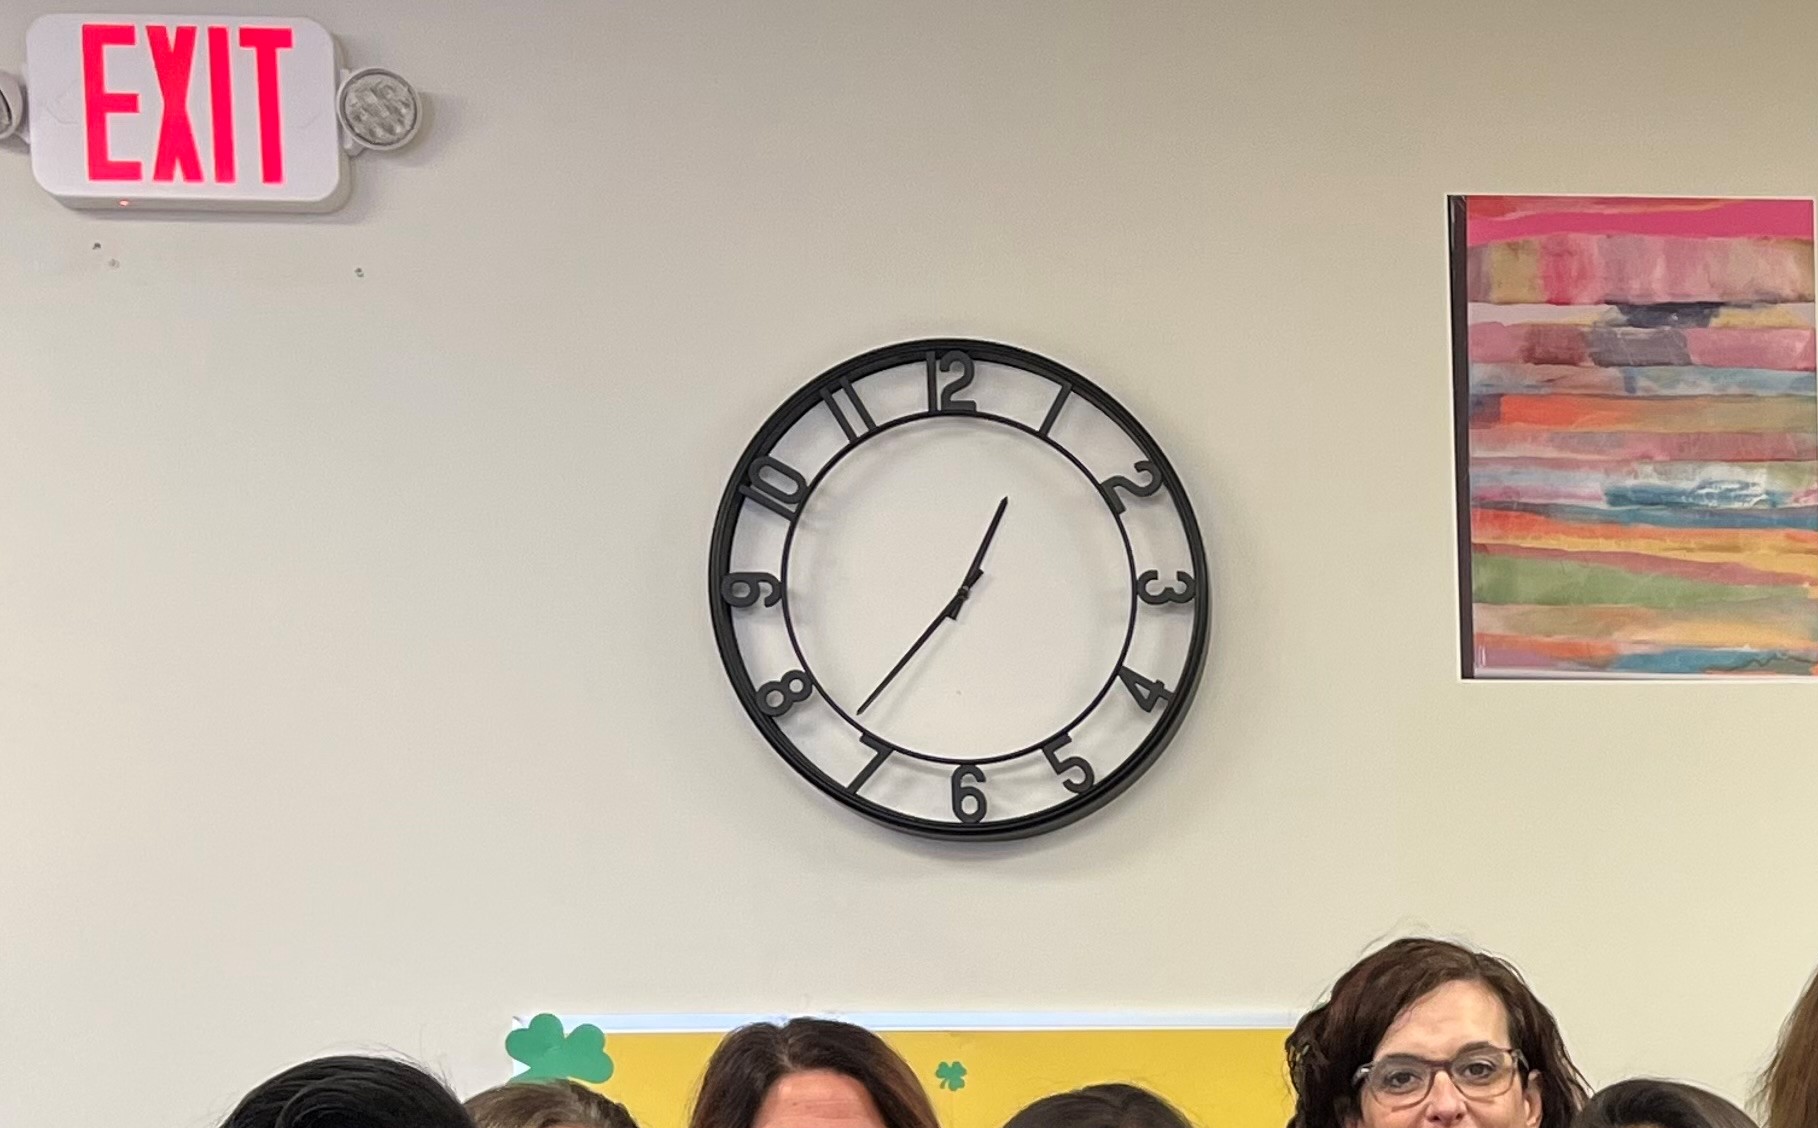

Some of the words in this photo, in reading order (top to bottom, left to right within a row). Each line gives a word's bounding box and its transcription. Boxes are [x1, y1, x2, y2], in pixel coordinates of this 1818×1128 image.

[82, 24, 293, 184] EXIT
[820, 376, 877, 442] 11
[926, 350, 977, 413] 12
[1039, 382, 1072, 438] 1
[739, 456, 808, 522] 10
[1100, 460, 1163, 515] 2
[720, 572, 782, 608] 9
[1136, 569, 1196, 605] 3
[756, 670, 813, 717] 8
[1118, 666, 1176, 713] 4
[847, 730, 896, 795] 7
[1042, 732, 1095, 794] 5
[951, 764, 987, 824] 6
